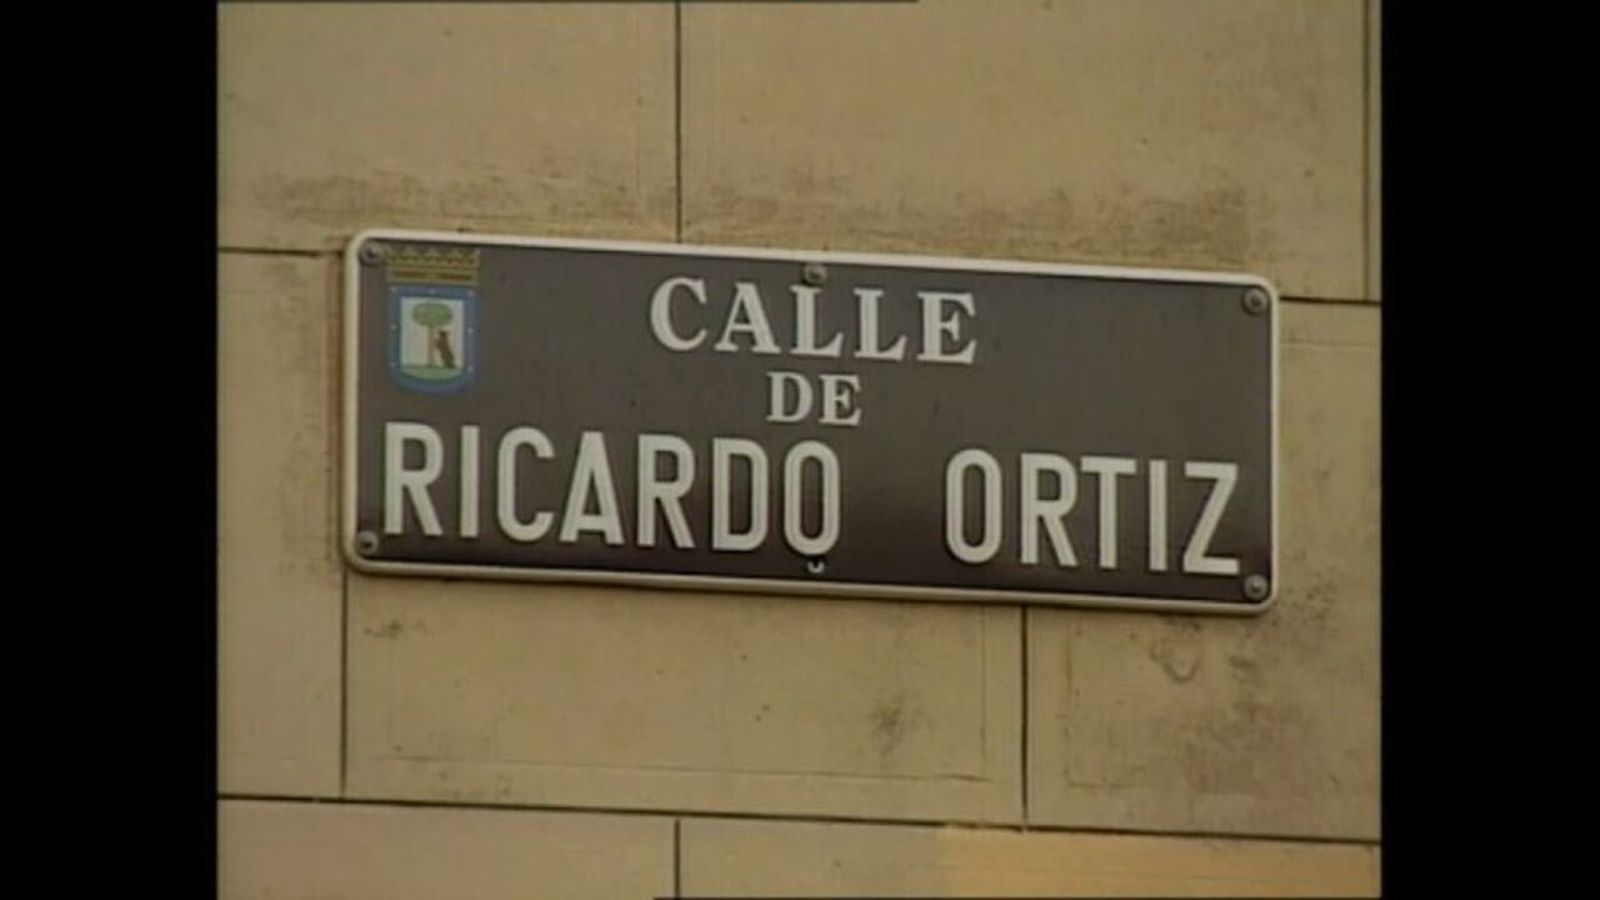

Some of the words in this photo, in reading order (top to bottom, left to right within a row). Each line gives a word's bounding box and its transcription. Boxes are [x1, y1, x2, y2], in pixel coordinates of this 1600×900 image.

[650, 277, 977, 364] CALLE
[767, 372, 862, 426] DE
[384, 421, 840, 555] RICARDO
[946, 448, 1239, 575] ORTIZ
